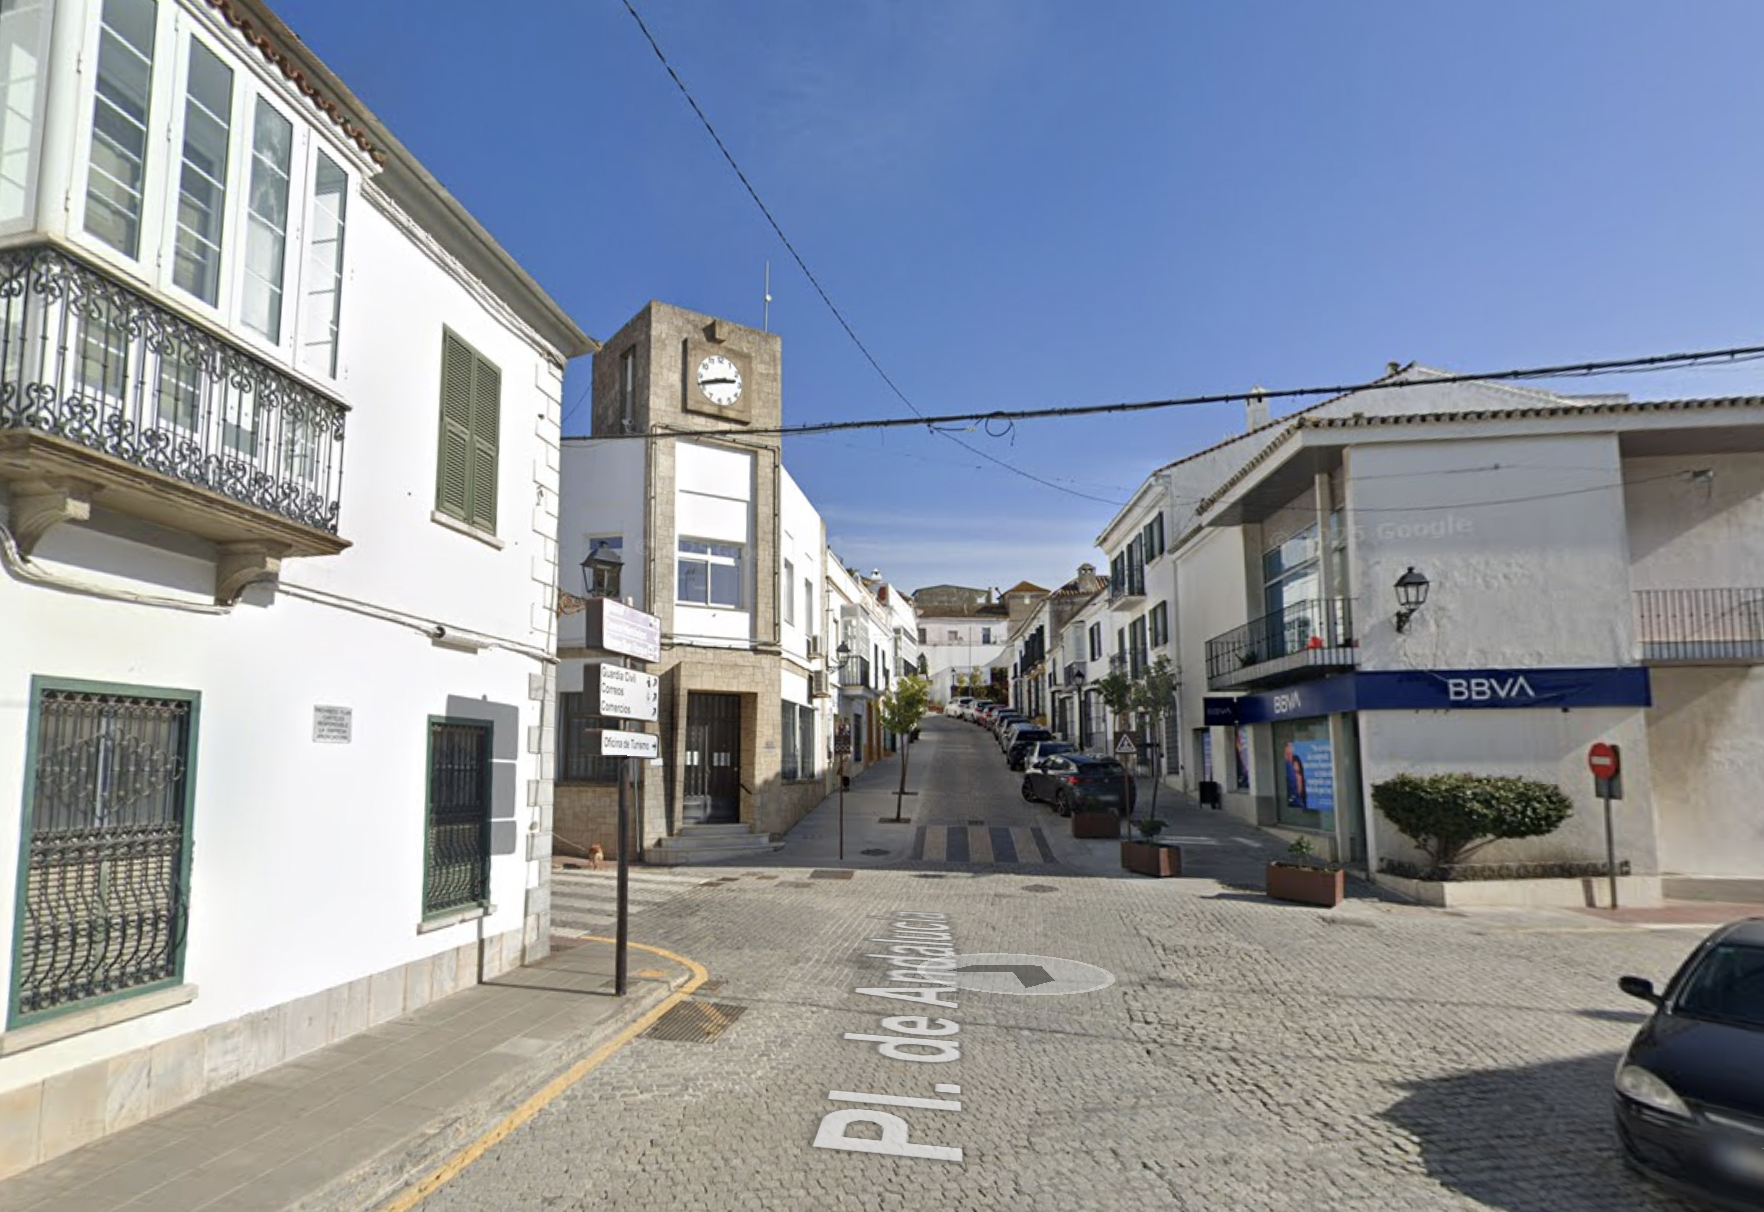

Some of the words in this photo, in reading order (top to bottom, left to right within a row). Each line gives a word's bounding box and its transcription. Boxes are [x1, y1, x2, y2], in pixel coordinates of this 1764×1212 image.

[717, 356, 724, 364] 12
[602, 666, 624, 681] Guardia
[624, 672, 636, 684] Civil
[602, 682, 624, 696] Correos
[1448, 676, 1536, 701] BBVA
[602, 700, 631, 715] Comercios
[1273, 691, 1302, 714] BBVA
[604, 737, 623, 749] Oficina
[624, 738, 630, 749] de
[631, 739, 650, 751] Turismo
